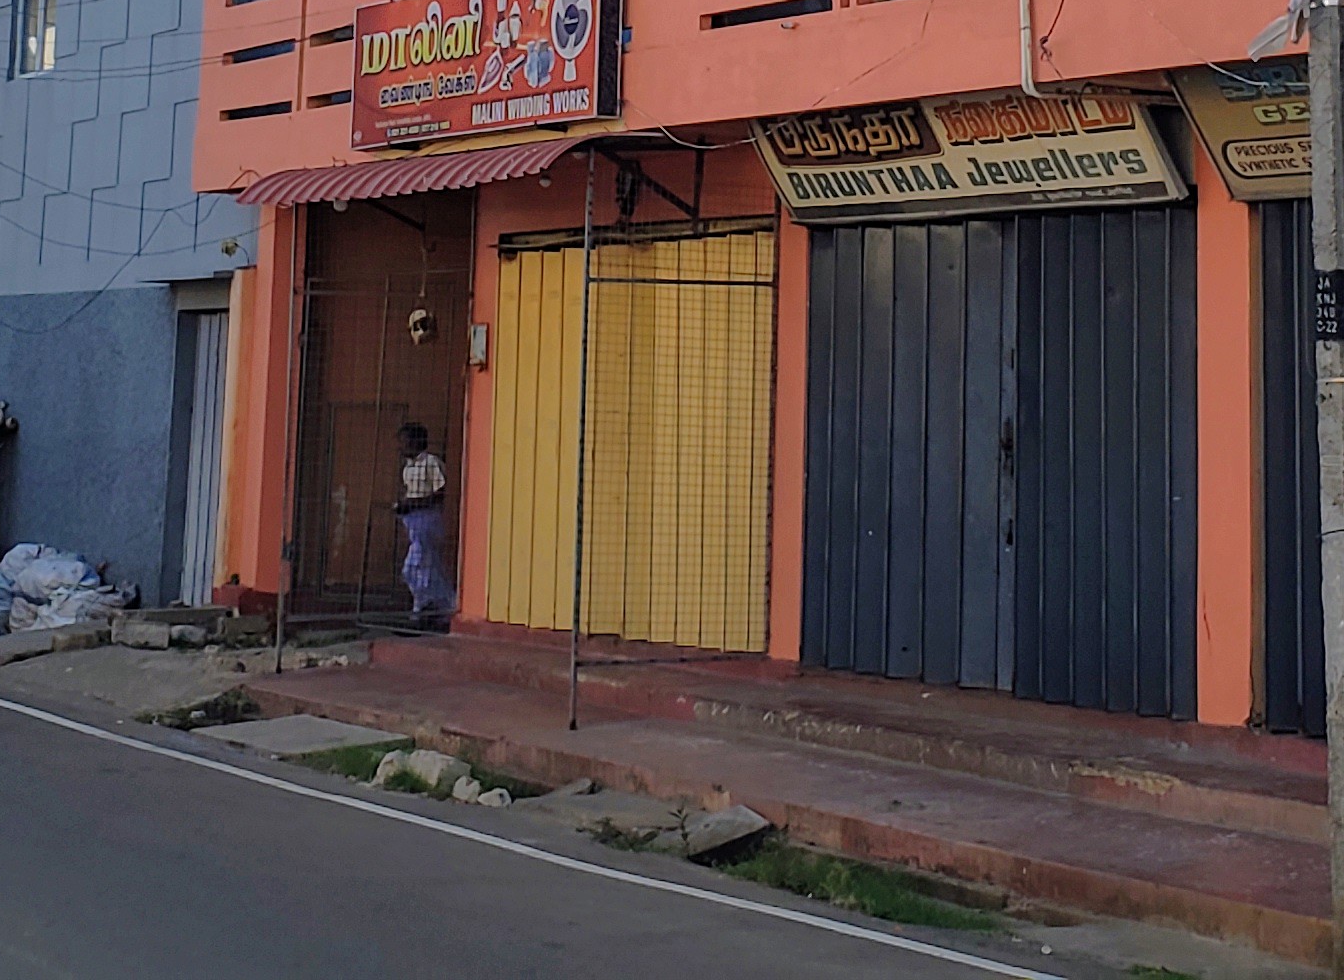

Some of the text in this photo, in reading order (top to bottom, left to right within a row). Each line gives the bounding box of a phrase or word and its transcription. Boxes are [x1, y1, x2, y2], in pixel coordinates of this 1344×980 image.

[472, 87, 590, 125] MALINI WINDING WORKS
[1234, 141, 1294, 157] PRECIOUS
[786, 148, 1148, 200] BIRUNTHAA Jewellers
[1237, 158, 1300, 173] SYNTHETIC
